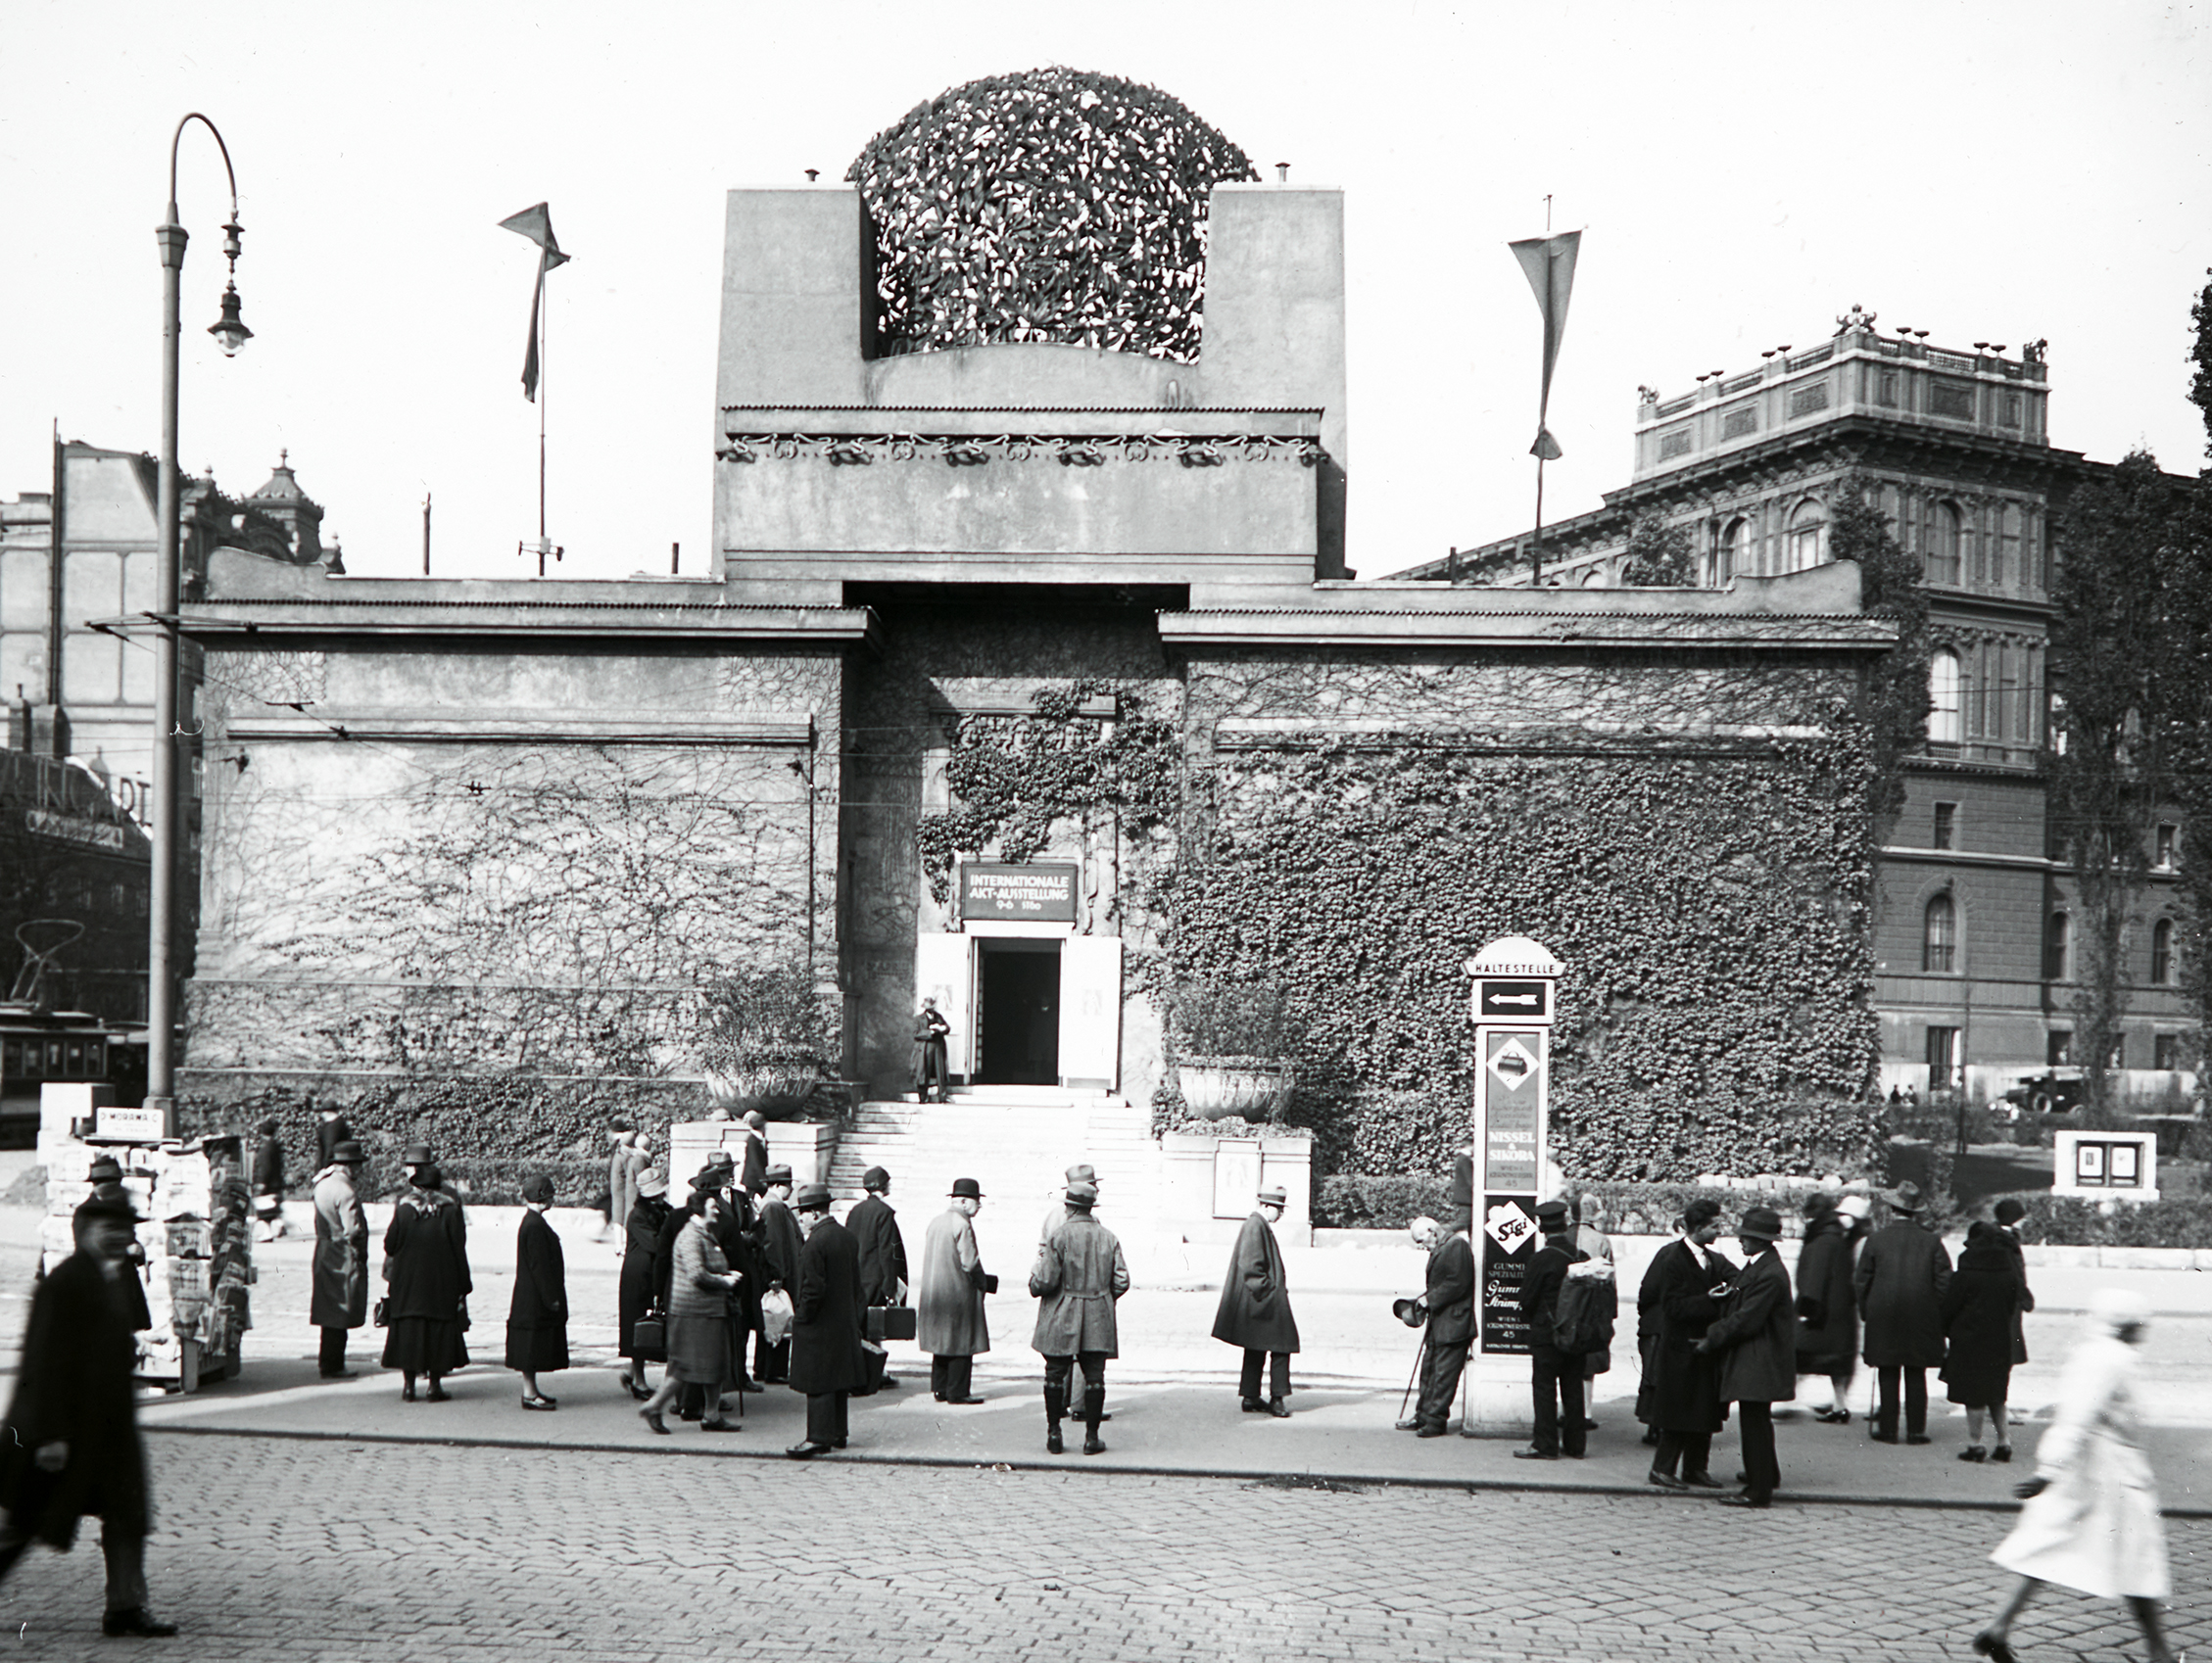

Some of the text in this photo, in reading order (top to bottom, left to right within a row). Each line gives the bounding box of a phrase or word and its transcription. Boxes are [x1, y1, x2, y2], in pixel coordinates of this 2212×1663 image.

[970, 874, 1070, 888] INTERNATIONALE
[1475, 964, 1555, 974] HALTESTELLE
[1488, 1131, 1536, 1143] NISSEL
[1489, 1149, 1536, 1162] SIKORA
[1498, 1217, 1527, 1242] Sigi
